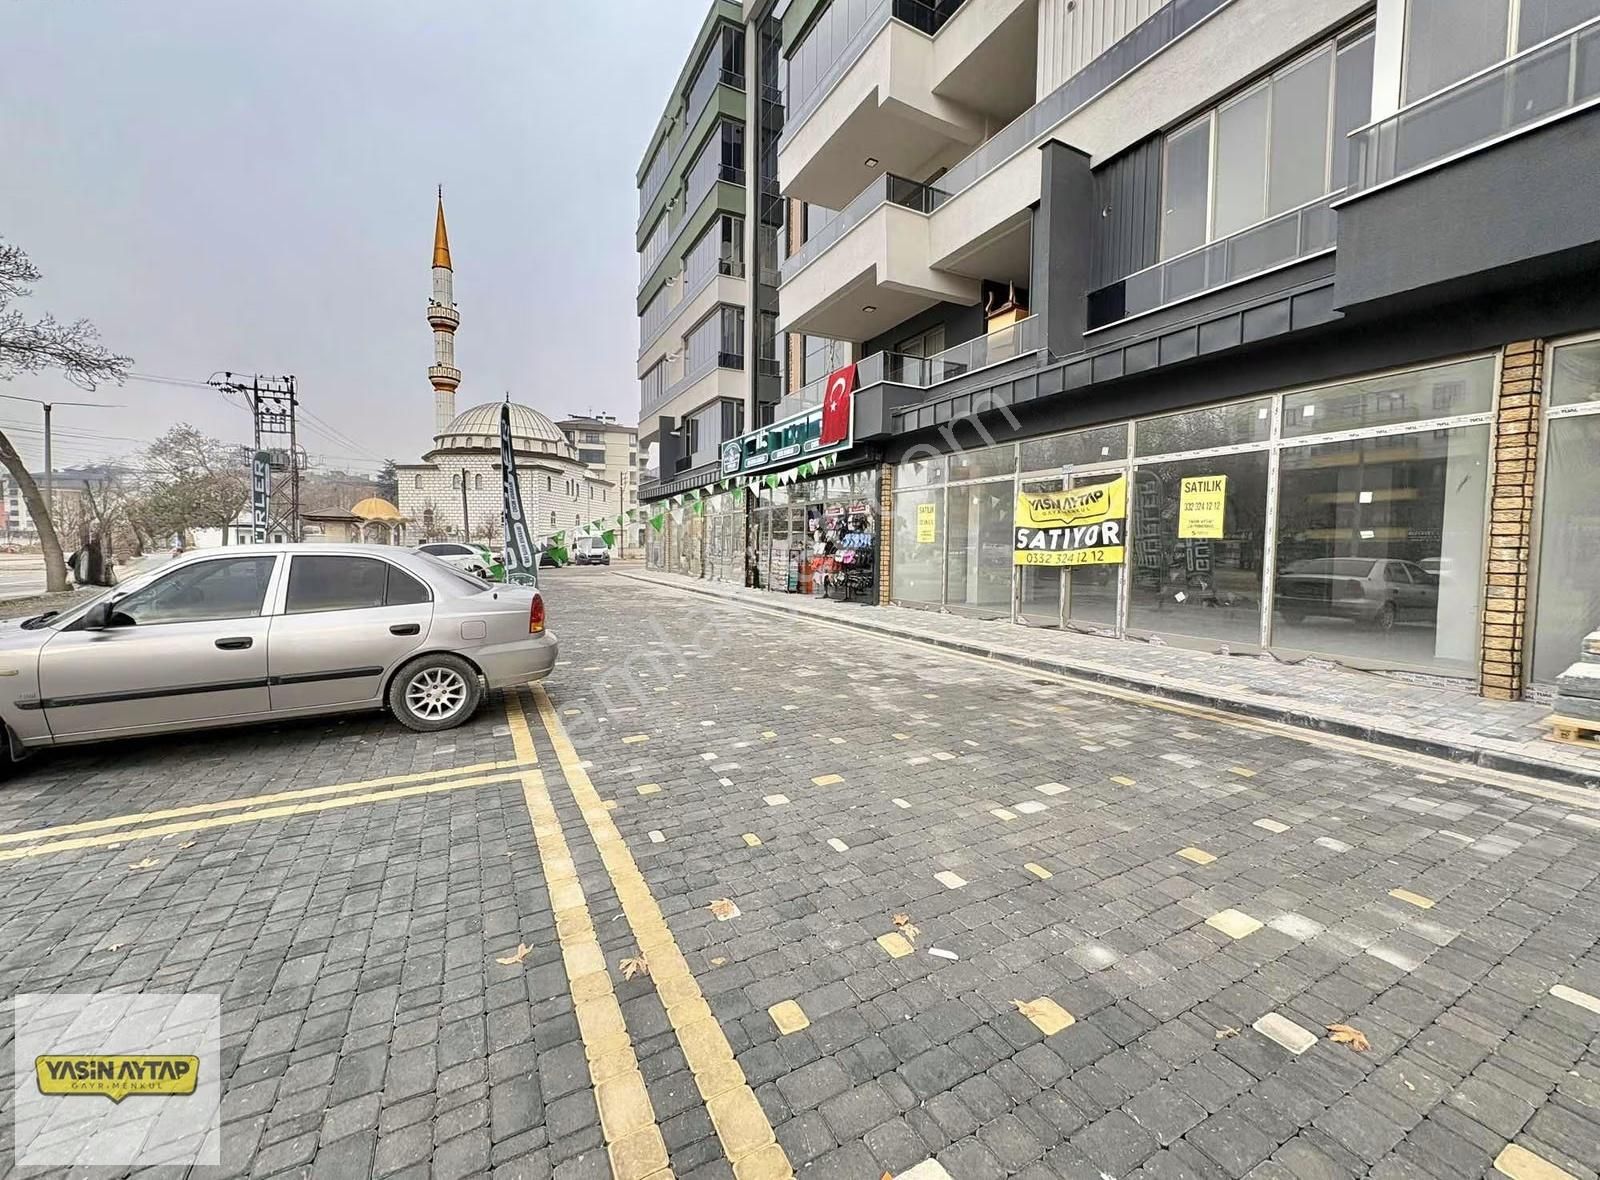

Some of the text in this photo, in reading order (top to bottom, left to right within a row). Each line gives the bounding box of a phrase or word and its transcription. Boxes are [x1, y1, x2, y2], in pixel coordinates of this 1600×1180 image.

[1184, 480, 1222, 493] SATILIK
[254, 459, 266, 544] ÜRLER
[1028, 490, 1104, 511] YASN AYTAP
[1016, 521, 1120, 550] SATIYOR
[1026, 550, 1105, 564] 0332 324 12 12
